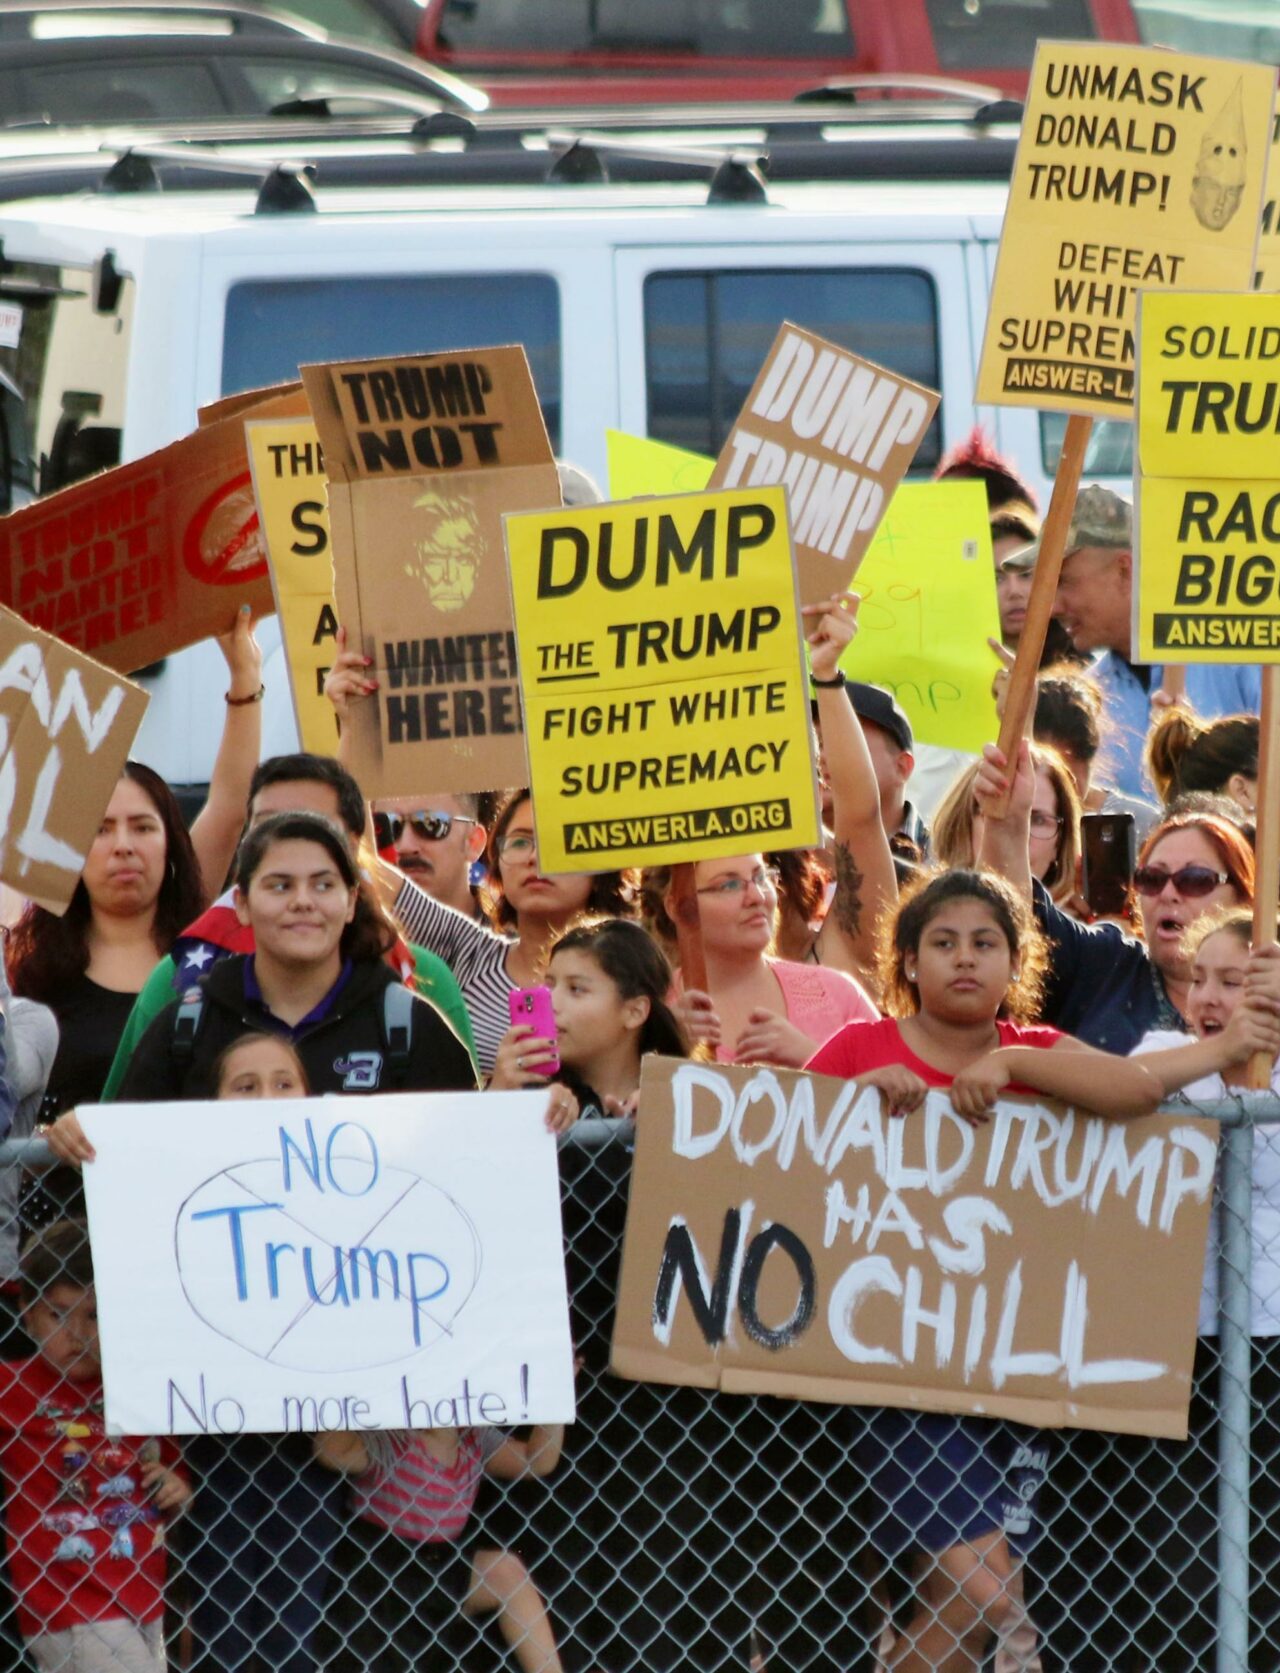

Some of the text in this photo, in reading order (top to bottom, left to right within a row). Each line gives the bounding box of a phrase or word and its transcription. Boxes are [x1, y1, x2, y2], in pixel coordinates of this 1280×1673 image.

[1045, 63, 1207, 113] UNMASK
[1035, 114, 1177, 157] DONALD
[1028, 164, 1170, 212] TRUMP!
[1058, 242, 1185, 284] DEFEAT
[1054, 279, 1136, 320] WHI
[341, 363, 493, 424] TRUMP
[751, 332, 928, 472] DUMP
[357, 423, 503, 473] NOT
[18, 477, 160, 566] TRUMP
[537, 503, 776, 601] DUMP
[20, 517, 161, 606] NOT
[537, 605, 781, 672] THE TRUMP
[543, 681, 787, 741] FIGHT WHITE
[560, 739, 790, 798] SUPREMACY
[570, 802, 785, 851] ANSWERLA.ORG
[278, 1117, 379, 1197] NO
[671, 1064, 1217, 1235] DONALD TRUMP
[823, 1180, 1012, 1276] HAS
[191, 1202, 450, 1347] Trump
[652, 1200, 1169, 1390] NO CHILL
[167, 1363, 530, 1434] No more hate!
